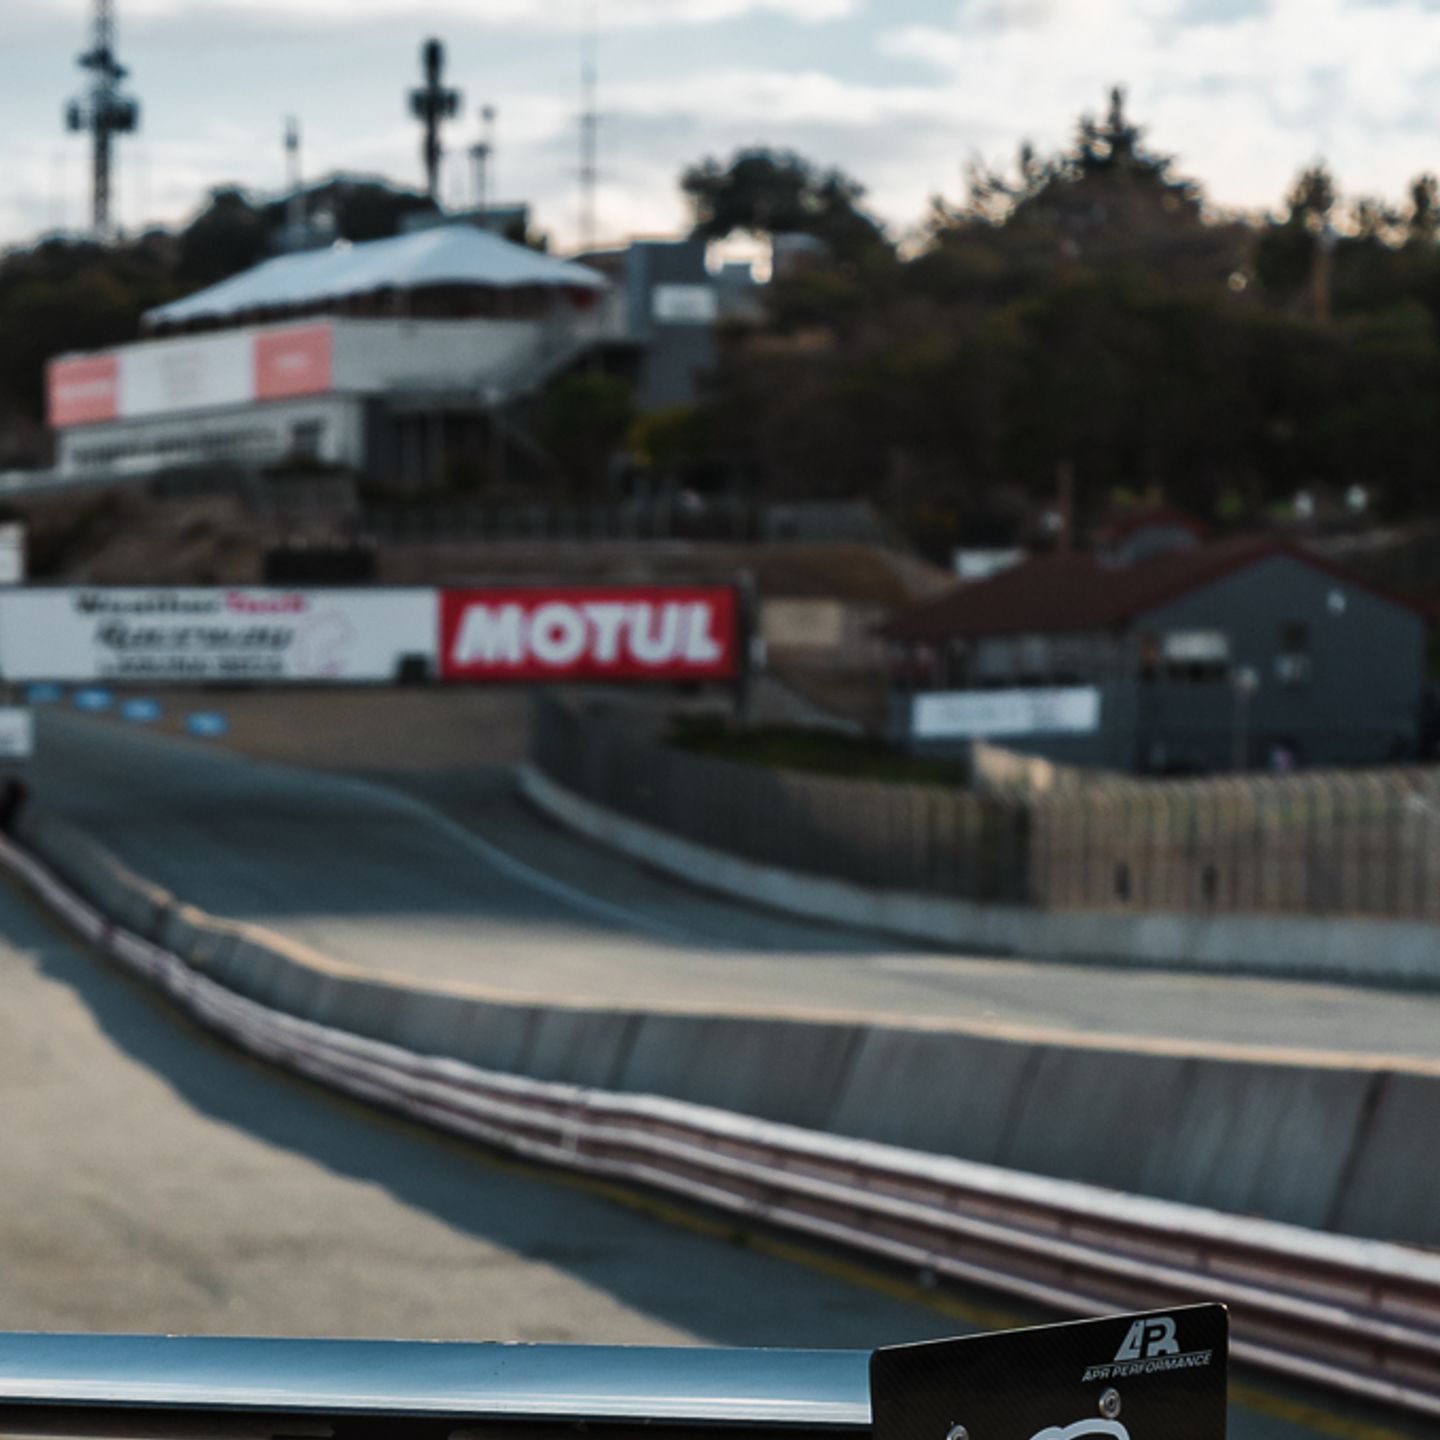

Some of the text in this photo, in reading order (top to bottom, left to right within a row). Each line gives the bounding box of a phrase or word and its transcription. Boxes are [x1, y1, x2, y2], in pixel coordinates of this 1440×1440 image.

[453, 602, 722, 665] MOTUL
[1082, 1354, 1212, 1383] APR PERFORMANCE
